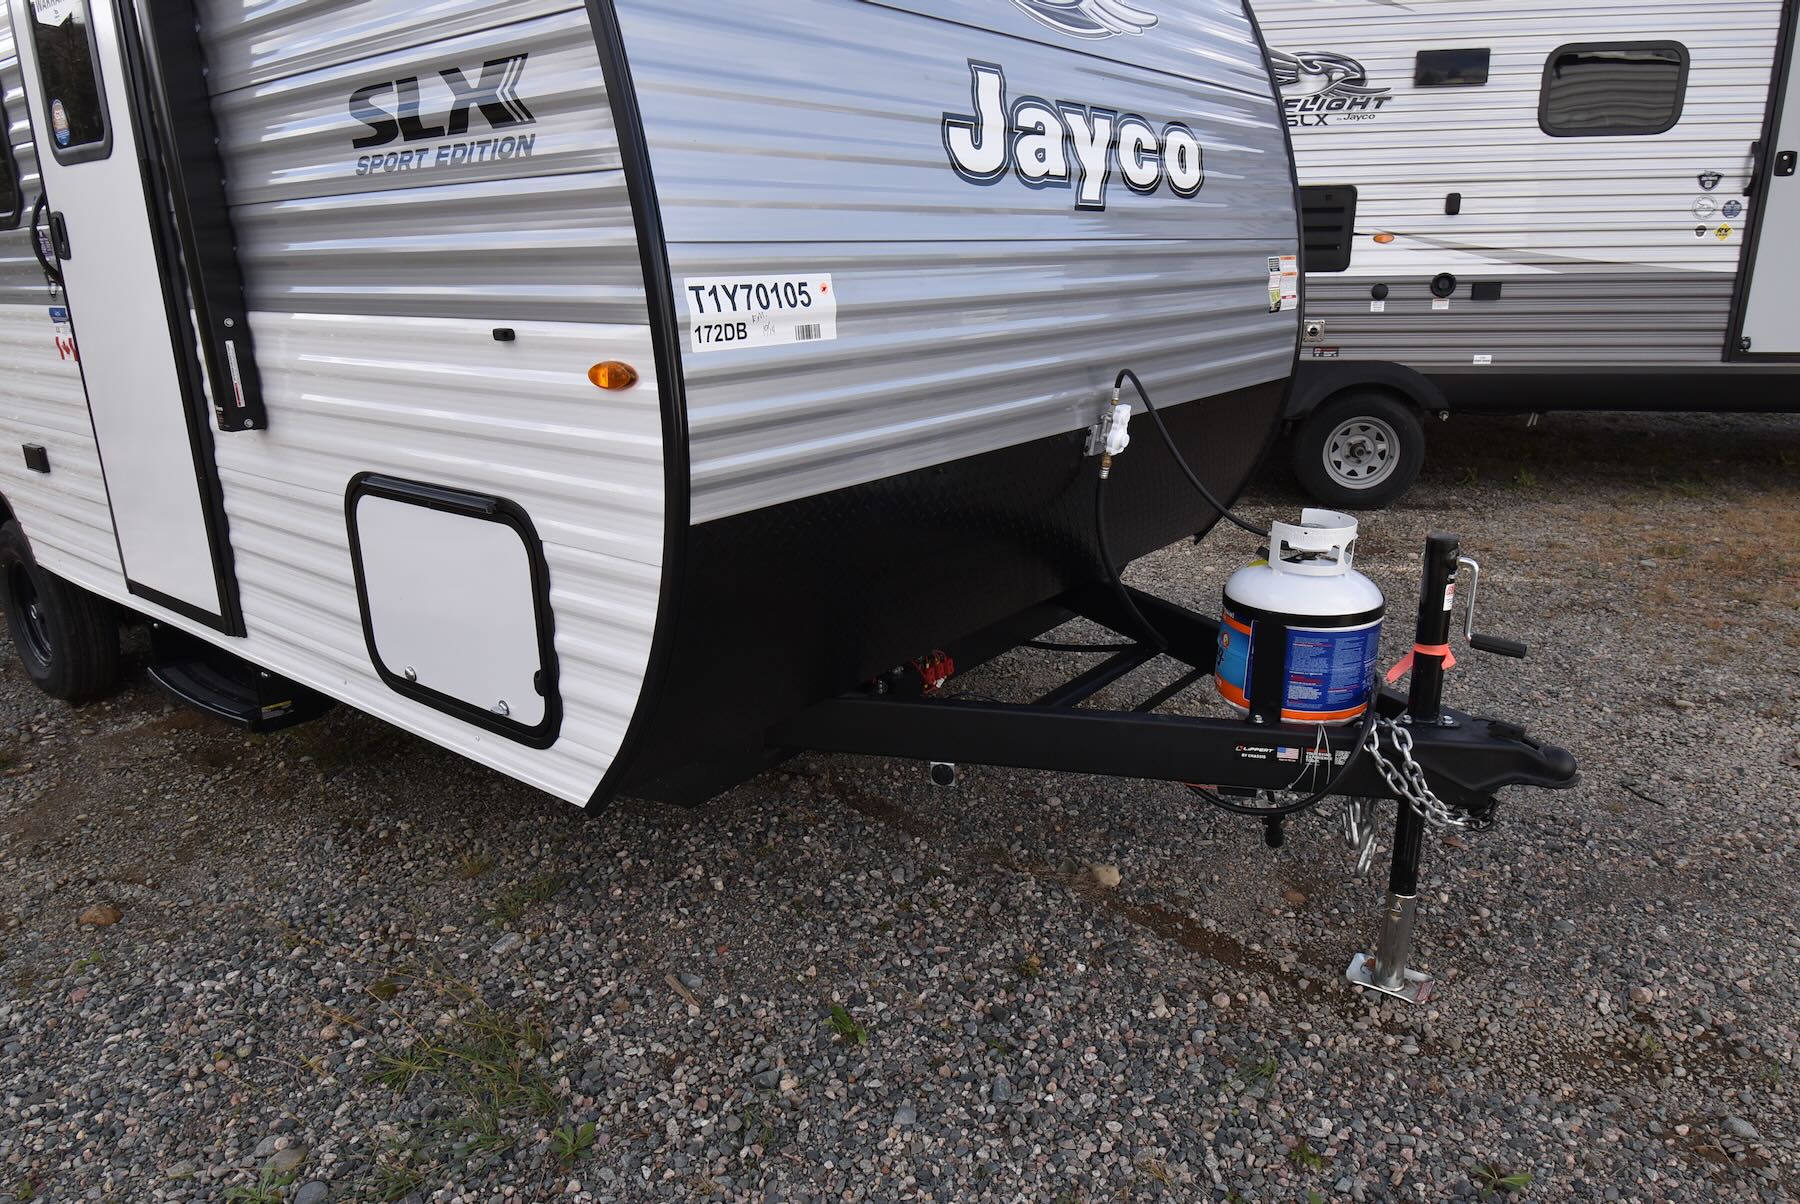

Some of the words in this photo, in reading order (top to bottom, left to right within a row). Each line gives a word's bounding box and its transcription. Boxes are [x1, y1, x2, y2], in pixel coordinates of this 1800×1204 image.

[349, 53, 537, 149] SLX
[1343, 112, 1376, 121] Jayco
[942, 58, 1204, 211] Jayco
[1286, 113, 1329, 127] SLX
[356, 148, 430, 176] SPORT
[435, 133, 536, 167] EDITION
[688, 282, 812, 313] T1Y70105
[694, 322, 748, 344] 172DB
